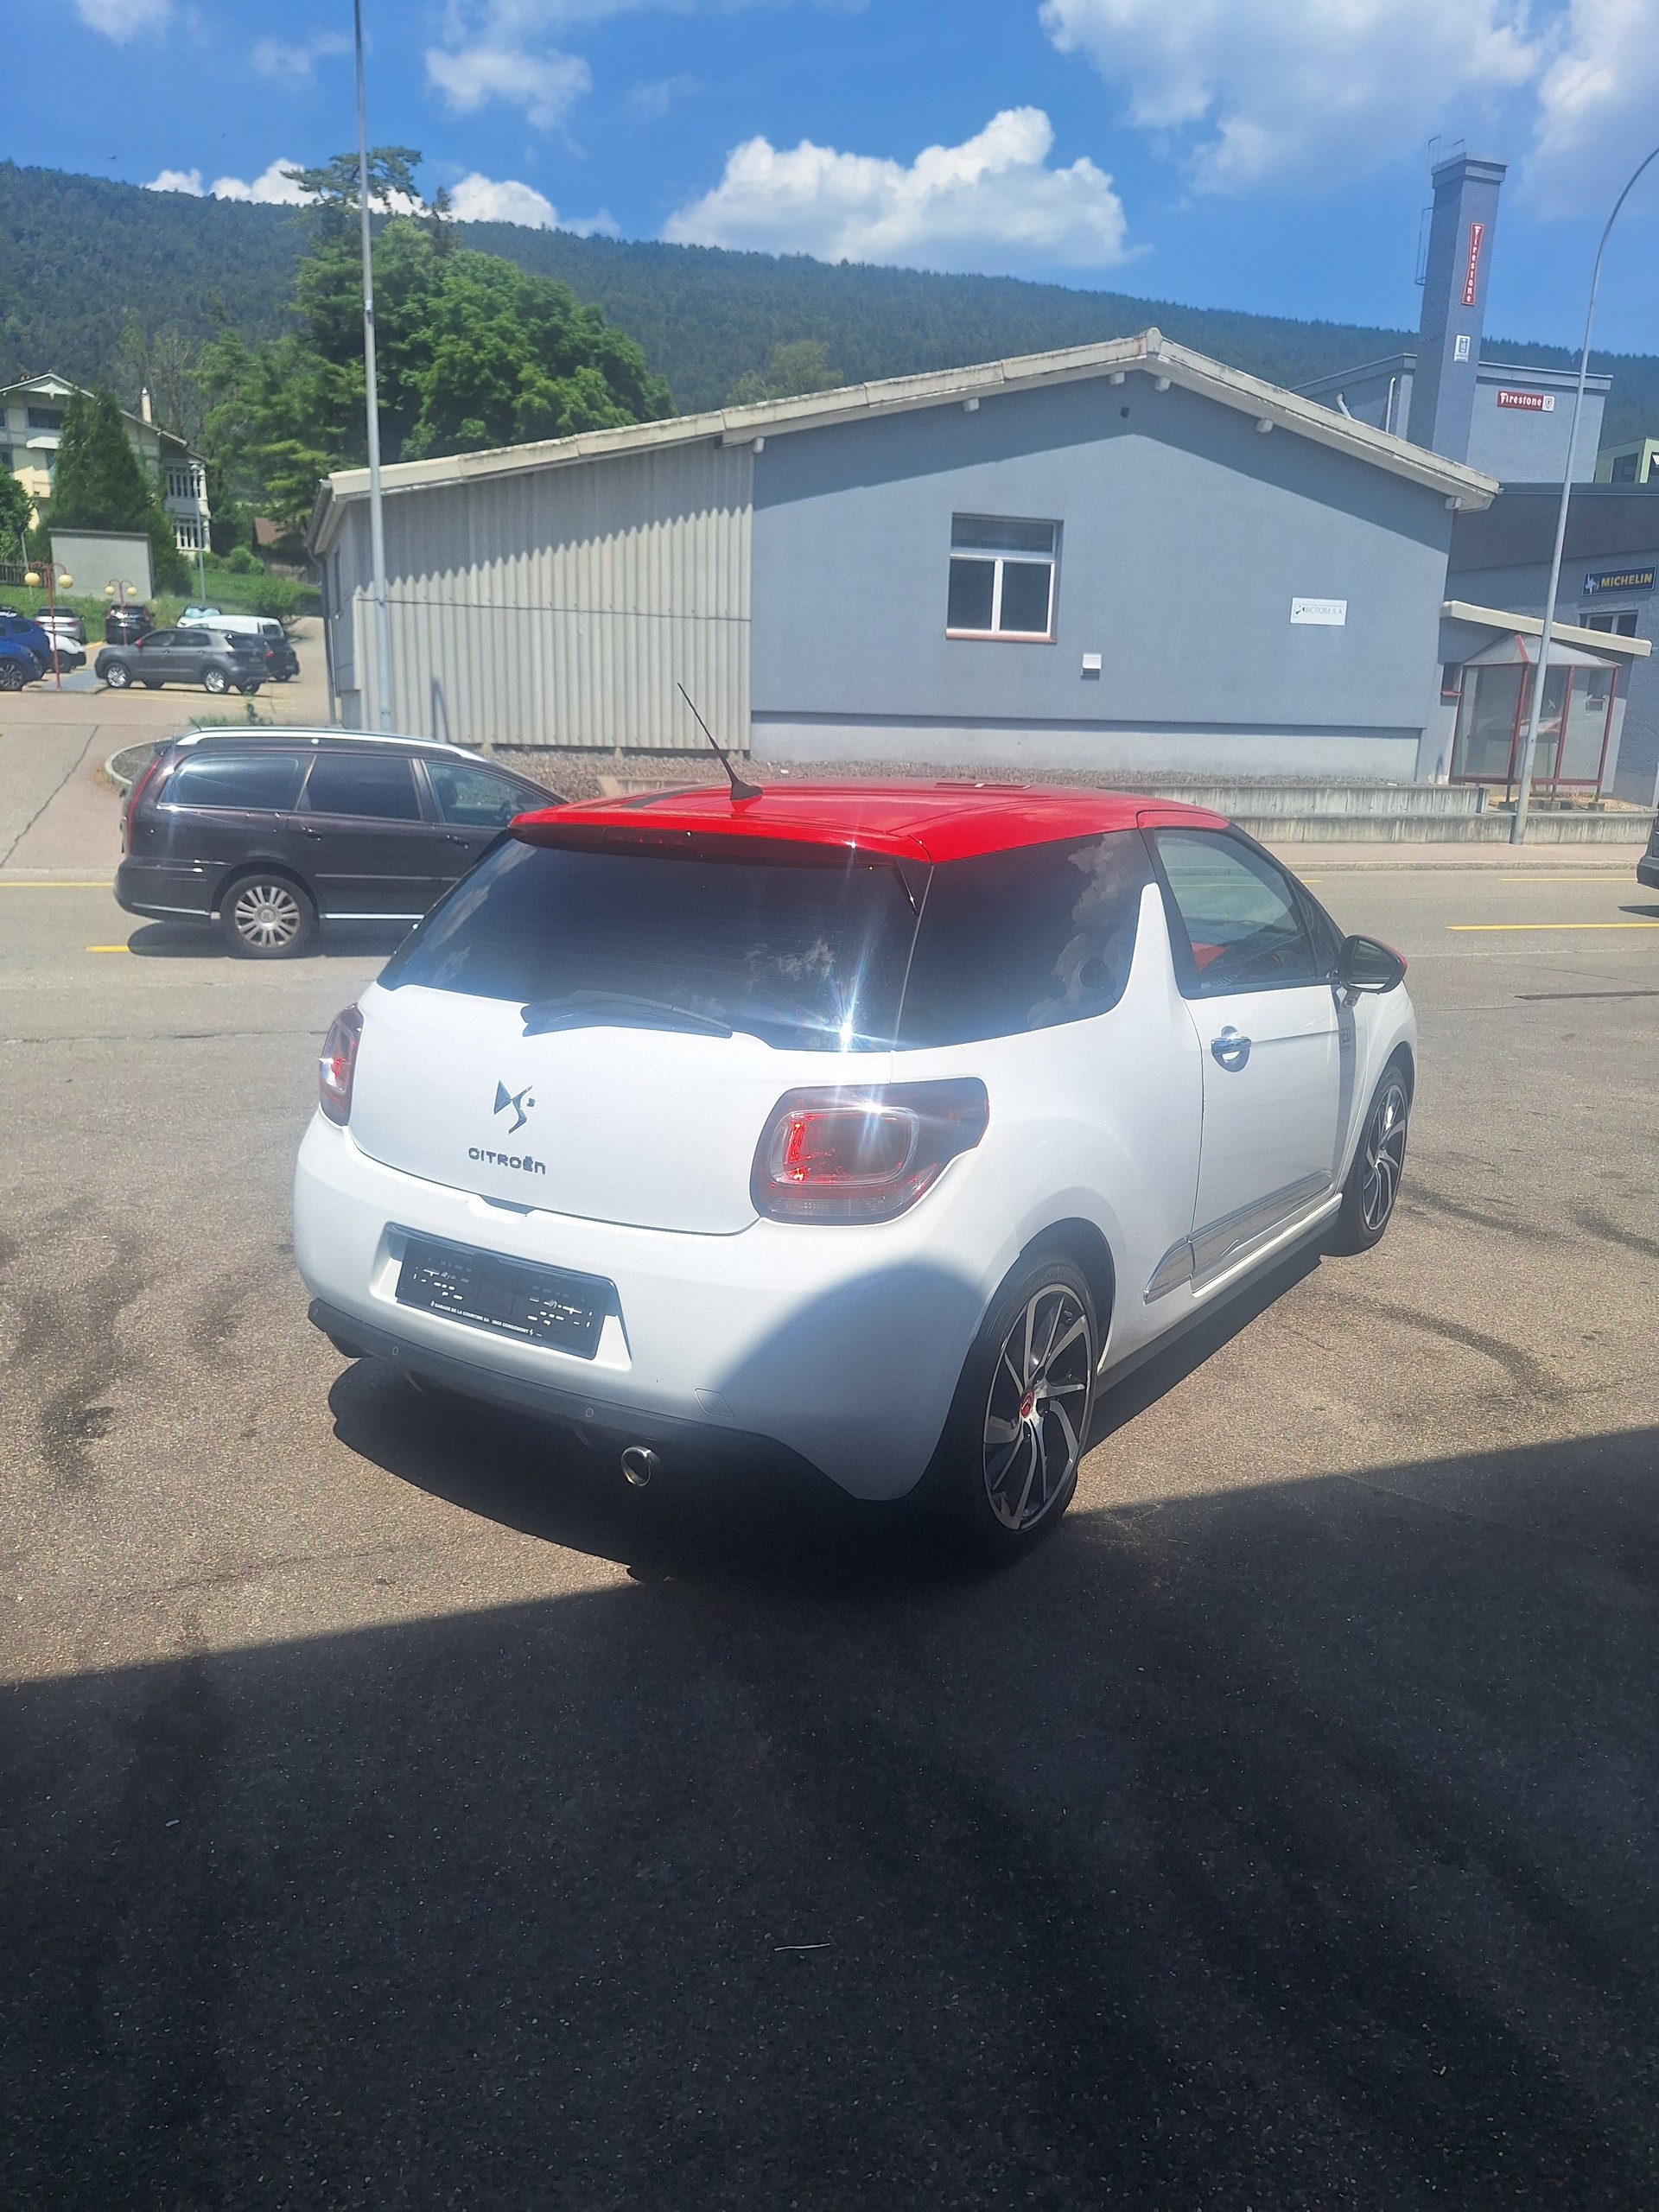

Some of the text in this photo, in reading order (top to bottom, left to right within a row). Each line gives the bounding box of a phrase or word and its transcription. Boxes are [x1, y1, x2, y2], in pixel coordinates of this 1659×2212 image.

[1466, 226, 1482, 302] Firestone
[1499, 391, 1542, 407] Firestone
[1600, 572, 1653, 588] MICHELIN
